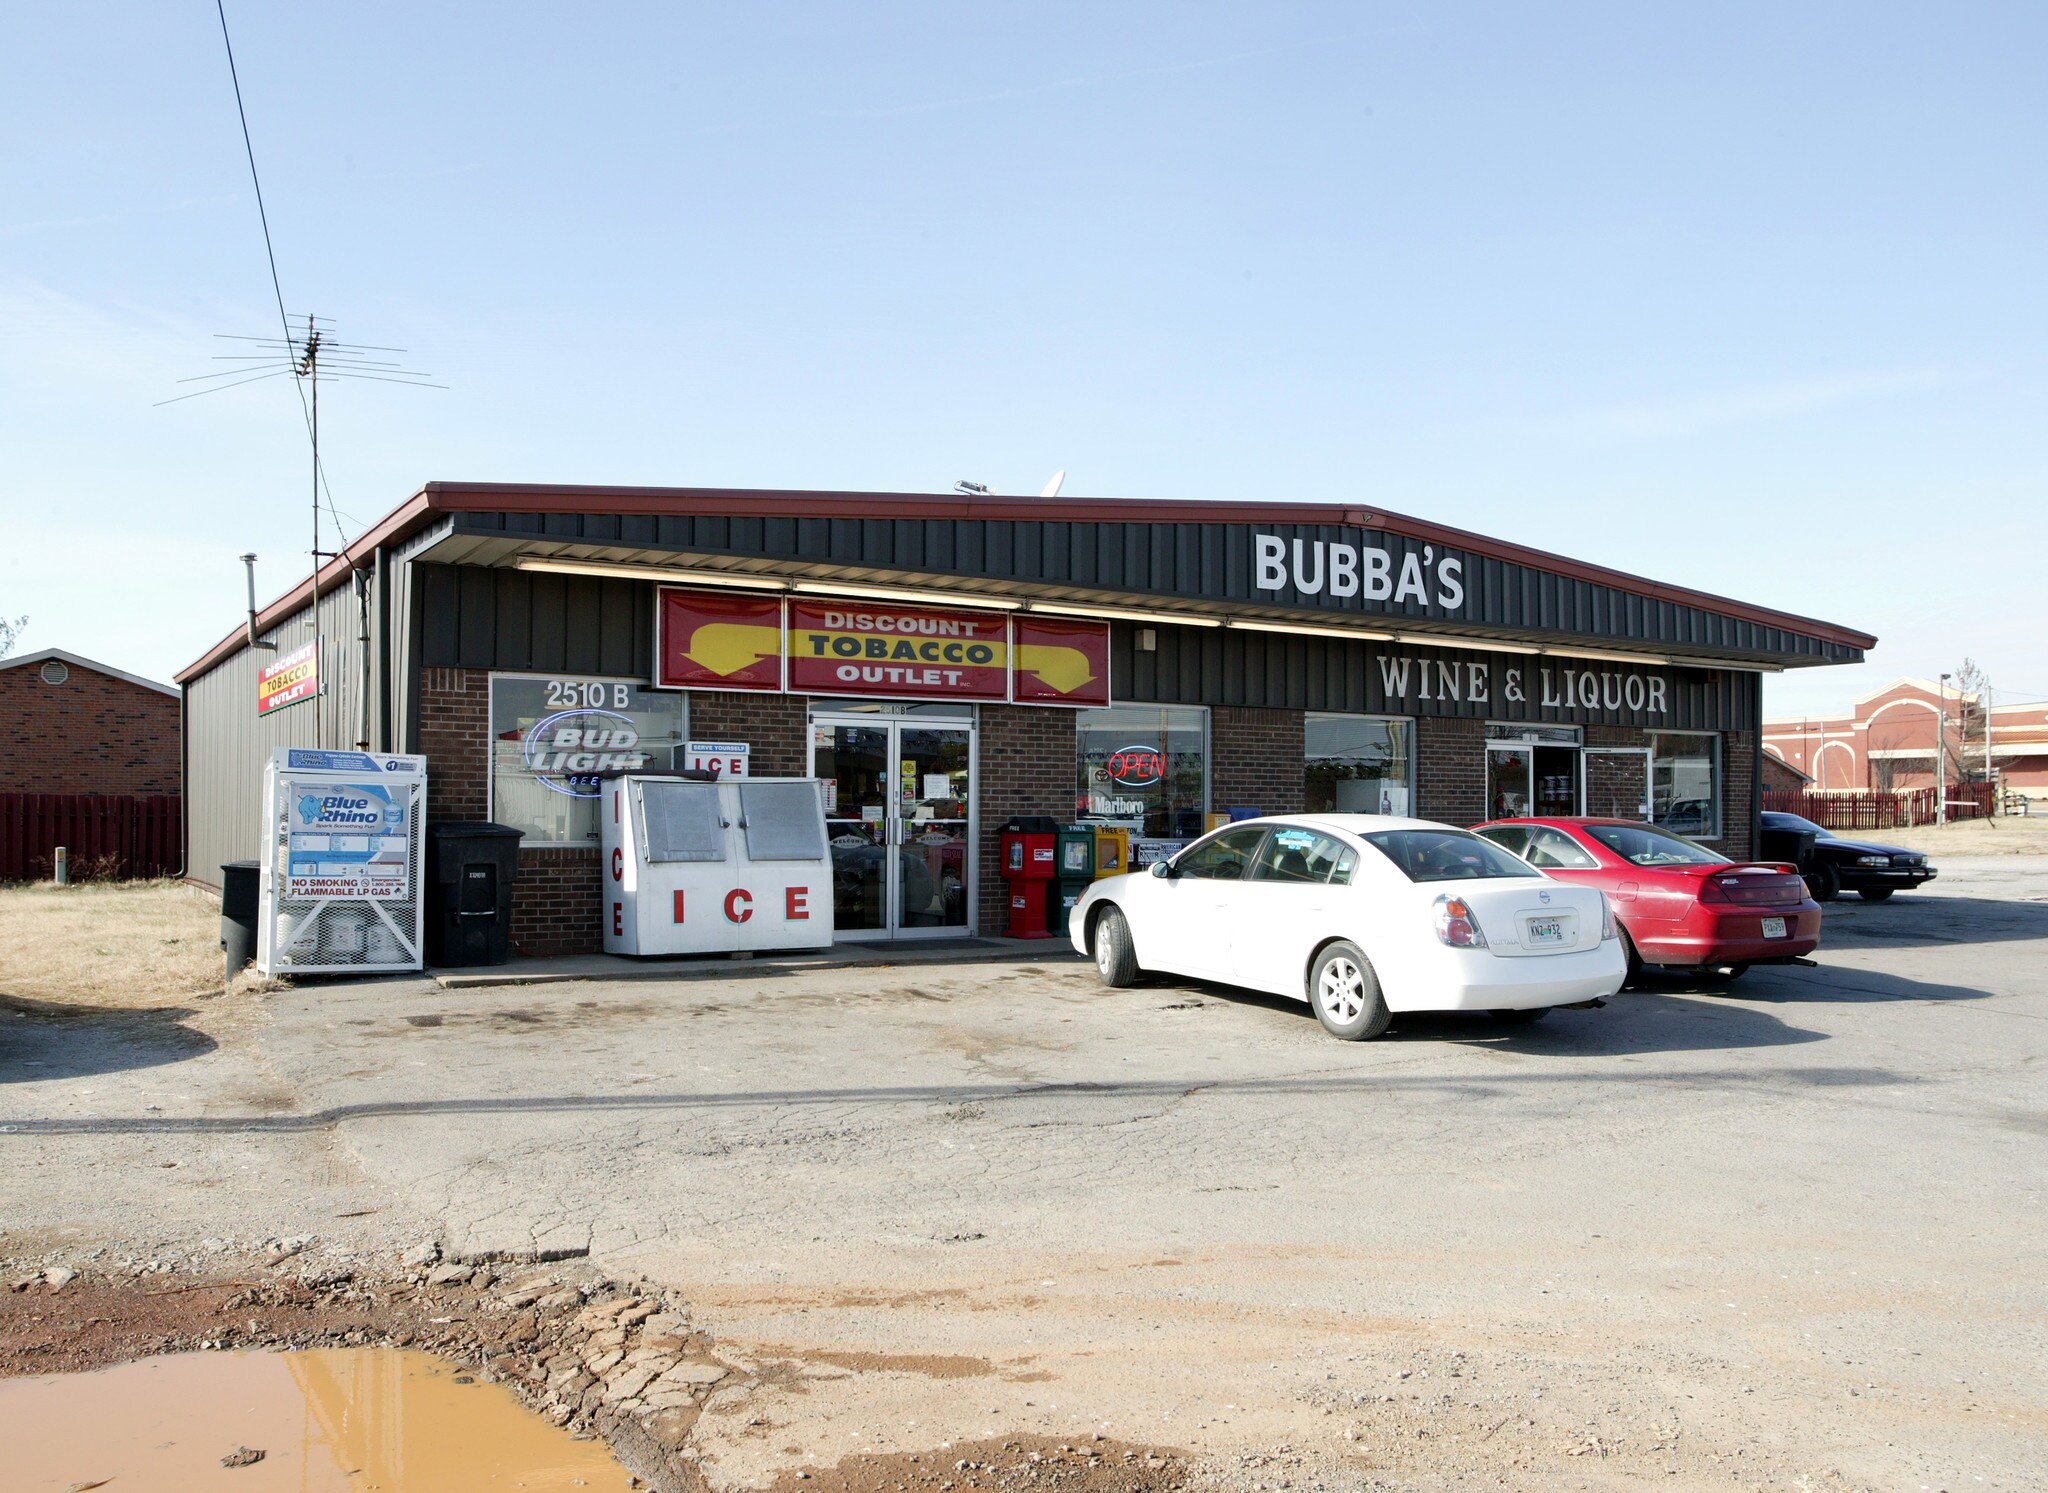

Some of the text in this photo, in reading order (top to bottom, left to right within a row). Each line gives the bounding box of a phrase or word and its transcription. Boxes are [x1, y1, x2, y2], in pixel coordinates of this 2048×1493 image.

[1255, 533, 1464, 609] BUBBA'S
[824, 613, 979, 636] DISCOUNT
[809, 634, 993, 664] TOBACCO
[265, 644, 313, 679] DISCOUNT
[267, 664, 308, 693] TOBACCO
[836, 665, 963, 687] OUTLET
[1376, 655, 1667, 713] WINE & LIQUOR
[268, 683, 305, 708] OUTLET
[547, 681, 629, 708] 2510 B
[552, 728, 638, 749] BUD
[693, 744, 712, 752] SERVE
[530, 753, 650, 771] LIGHT
[695, 757, 742, 774] ICE
[1108, 753, 1167, 778] OPEN
[570, 776, 600, 786] BEE
[322, 796, 369, 809] Blue
[1094, 796, 1144, 814] Marlboro
[318, 810, 378, 824] Rhino
[291, 878, 358, 887] NO SMOKING
[291, 888, 391, 896] FLAMMABLE LP GAS
[672, 886, 810, 924] ICE
